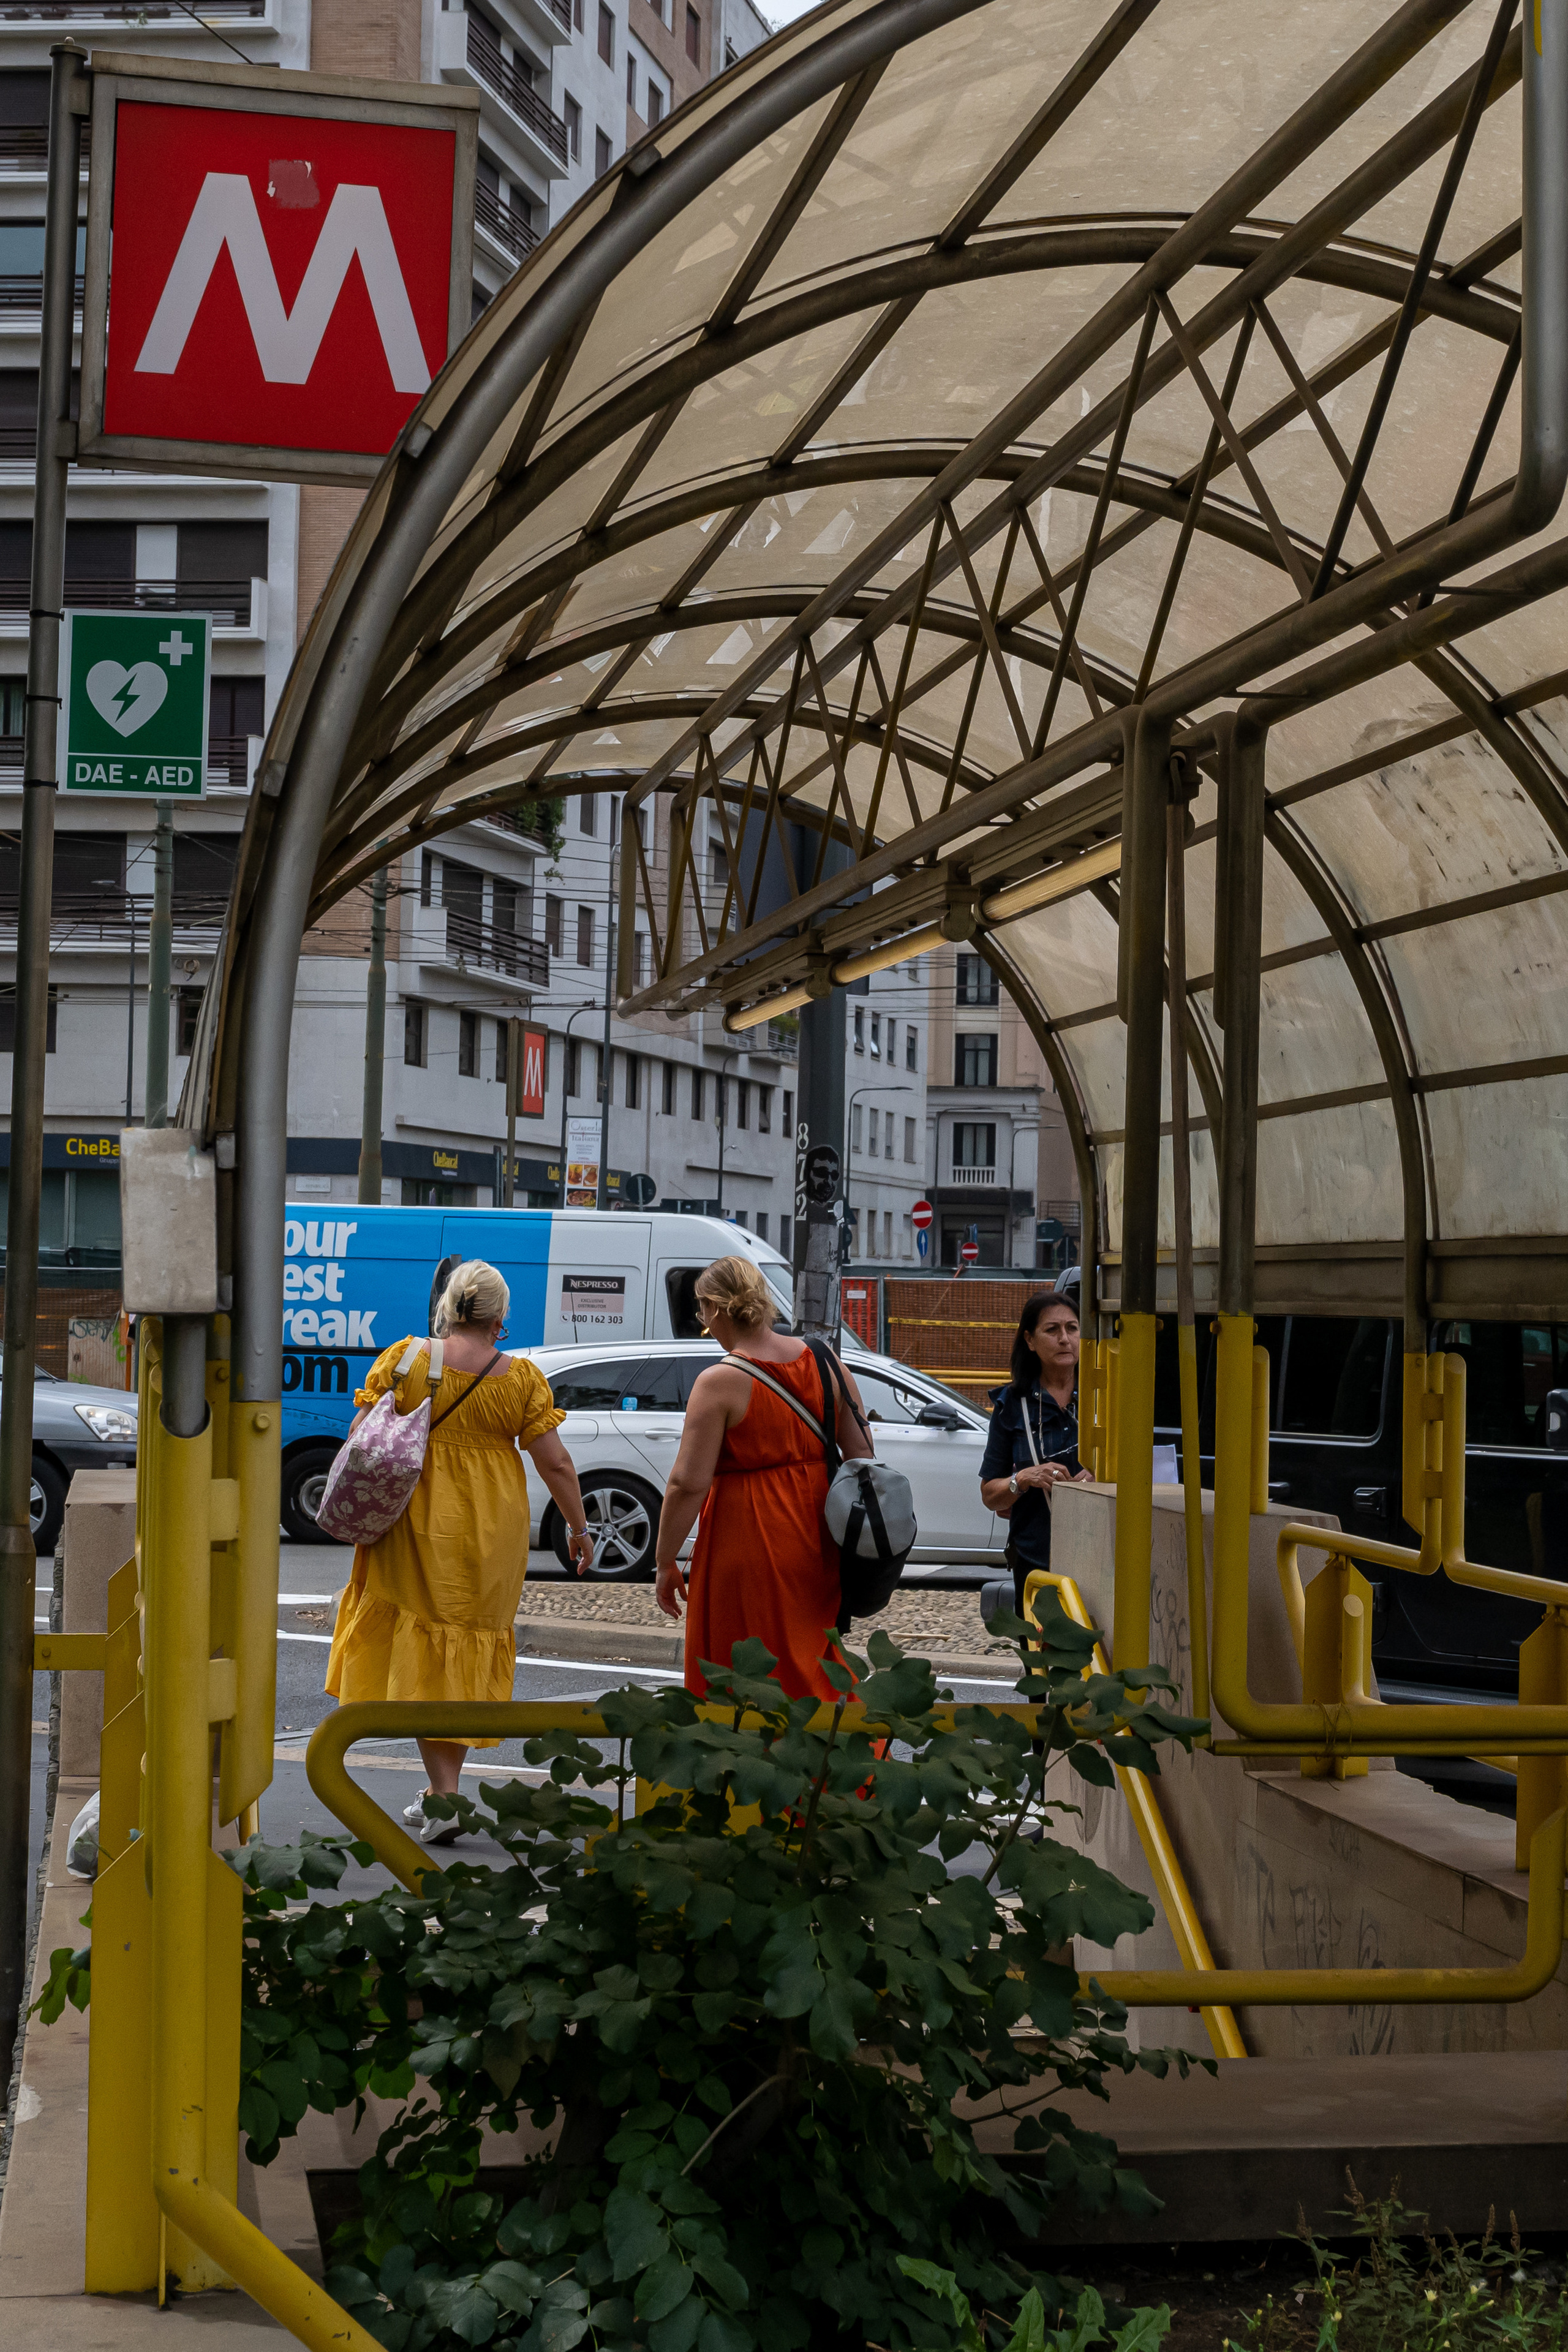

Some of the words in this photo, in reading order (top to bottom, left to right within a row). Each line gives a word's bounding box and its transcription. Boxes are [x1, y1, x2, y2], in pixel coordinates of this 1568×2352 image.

[134, 172, 432, 394] M
[75, 763, 123, 783] DAE
[144, 766, 194, 786] AED
[524, 1047, 542, 1098] M
[66, 1138, 119, 1156] CheBa
[284, 1220, 358, 1257] our
[283, 1262, 345, 1302] est
[570, 1279, 618, 1289] NESPRESSO
[282, 1354, 349, 1393] om
